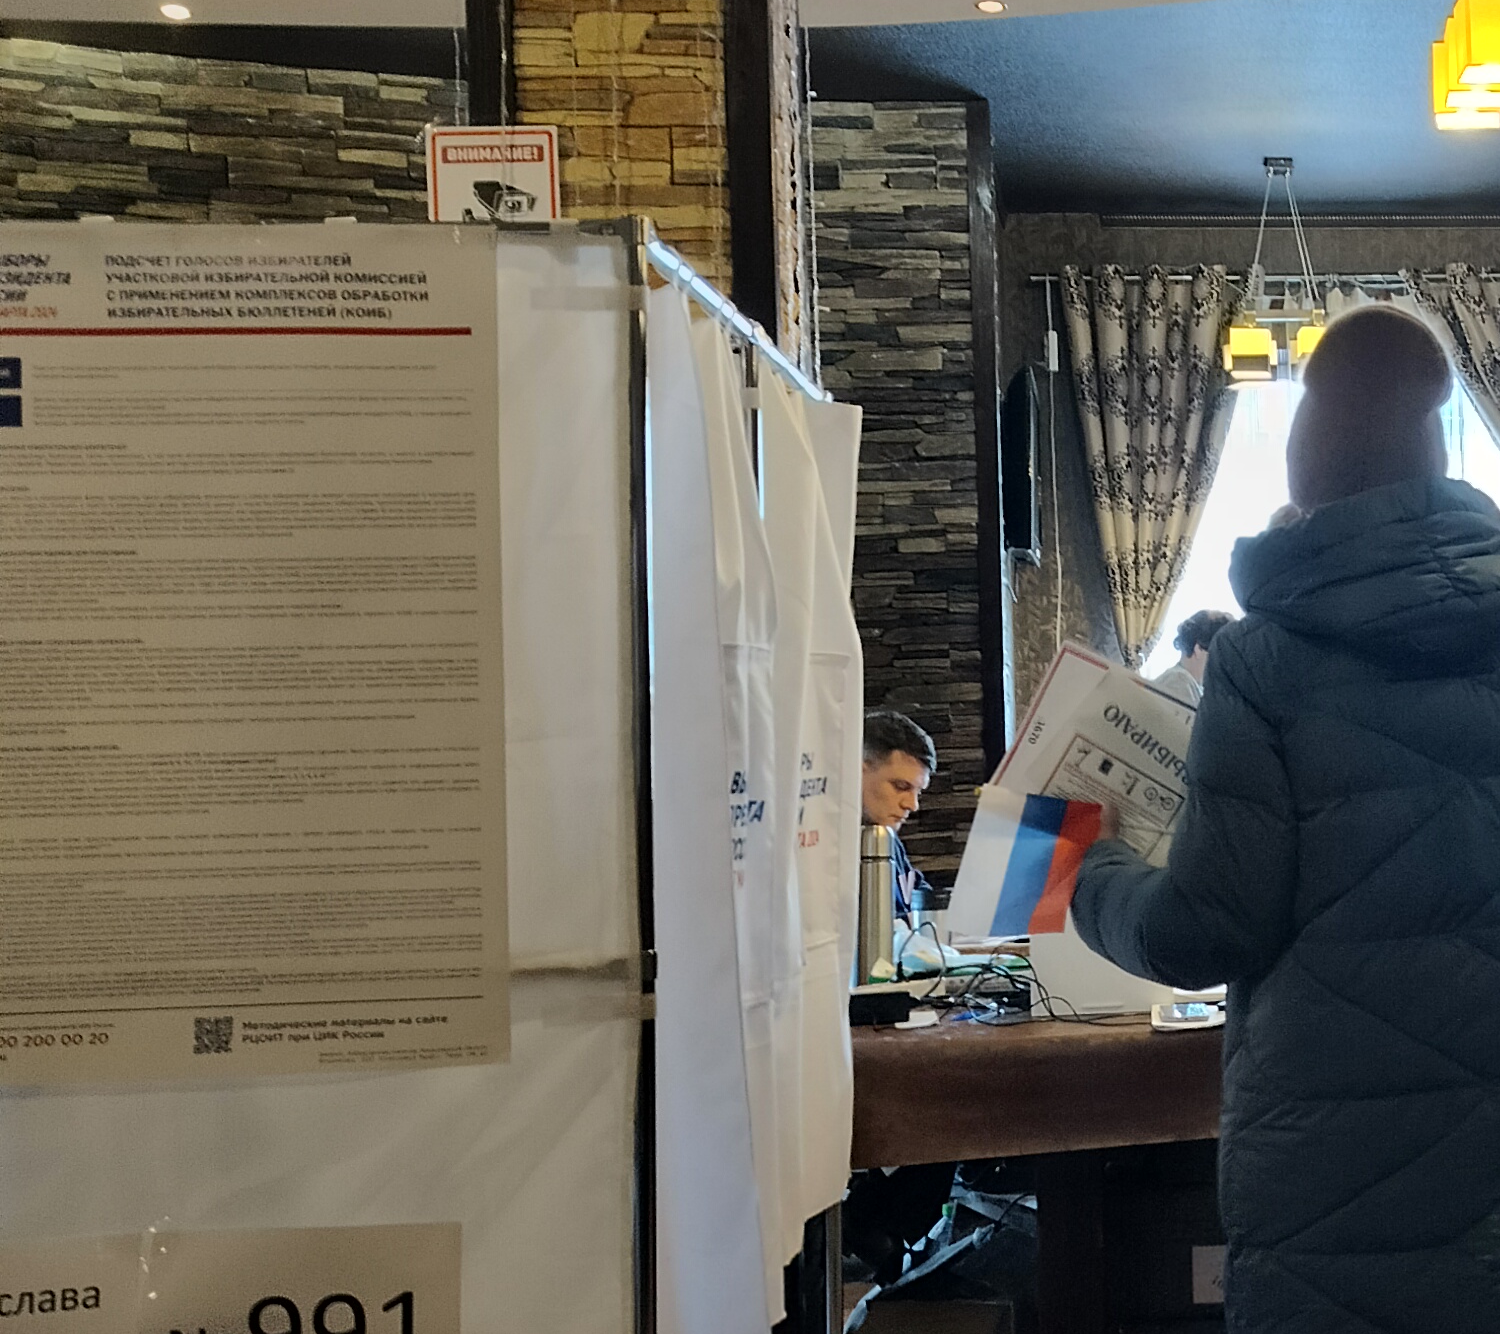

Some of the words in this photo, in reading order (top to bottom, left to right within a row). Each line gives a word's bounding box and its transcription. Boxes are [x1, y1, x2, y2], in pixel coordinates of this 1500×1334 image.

[446, 146, 539, 162] ВНИМАНИЕ!
[105, 254, 170, 267] ПОДСЧЕТ
[175, 255, 243, 267] ГОЛОСОВ
[249, 252, 352, 267] ИЗБИРАТЕЛЕЙ
[105, 269, 200, 284] УЧАСТКОВОЙ
[204, 270, 330, 284] ИЗБИРАТЕЛЬНОЙ
[334, 270, 427, 284] КОМИССИЕЙ
[106, 290, 116, 301] С
[119, 289, 231, 301] ПРИМЕНЕНИЕМ
[235, 289, 337, 301] КОМПЛЕКСОВ
[341, 290, 429, 302] ОБРАБОТКИ
[107, 307, 233, 319] ИЗБИРАТЕЛЬНЫХ
[237, 304, 337, 319] БЮЛЛЕТЕНЕЙ
[340, 306, 393, 320] (КОИБ)
[242, 1020, 327, 1030] Методические
[331, 1018, 395, 1029] материалы
[399, 1017, 412, 1026] на
[23, 1034, 56, 1047] 200
[60, 1033, 84, 1046] 00
[88, 1031, 109, 1045] 20
[342, 1029, 385, 1039] России
